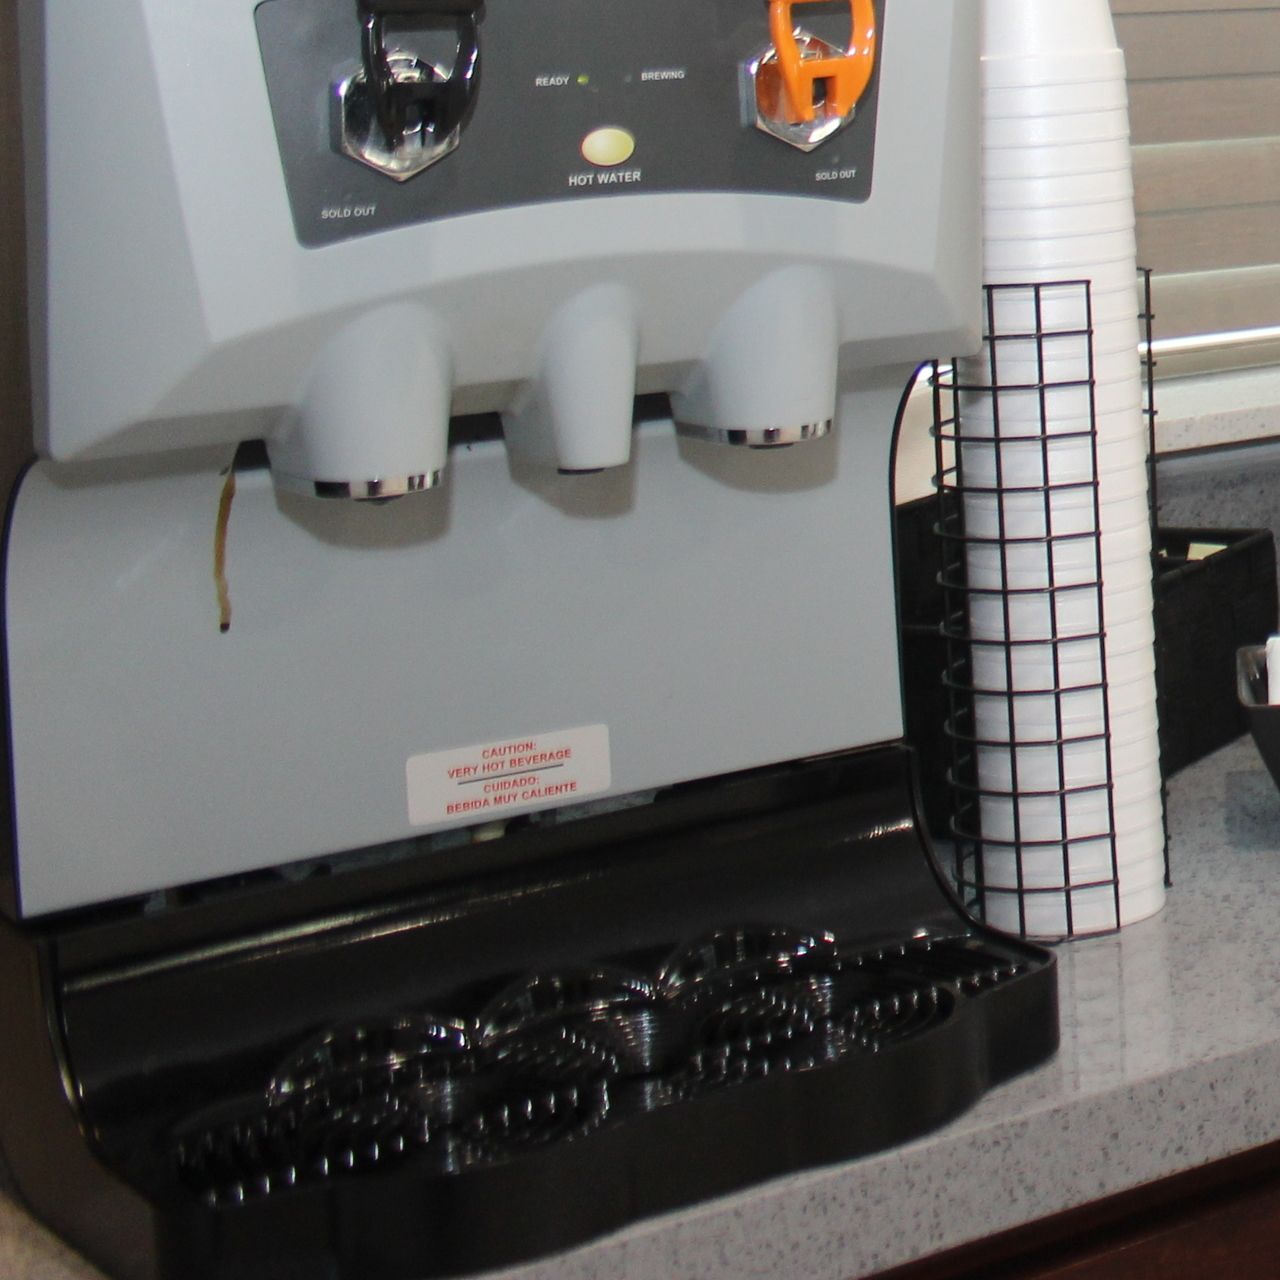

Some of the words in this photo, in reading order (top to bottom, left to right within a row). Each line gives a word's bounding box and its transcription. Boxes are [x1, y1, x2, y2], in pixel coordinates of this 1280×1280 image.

[535, 76, 570, 87] READY
[640, 69, 686, 82] BREWING
[568, 174, 594, 186] HOT
[596, 170, 642, 185] WATER
[814, 170, 838, 181] SOLD
[839, 169, 857, 180] OUT
[320, 208, 350, 220] SOLD
[353, 206, 377, 218] OUT
[482, 742, 537, 759] CAUTION:
[447, 764, 479, 779] VERY
[482, 761, 505, 774] HOT
[510, 748, 572, 768] BEVERAGE
[483, 776, 540, 794] CUIDADO:
[446, 800, 491, 815] BEBIDA
[493, 794, 518, 807] MUY
[522, 782, 577, 800] CALIENTE
